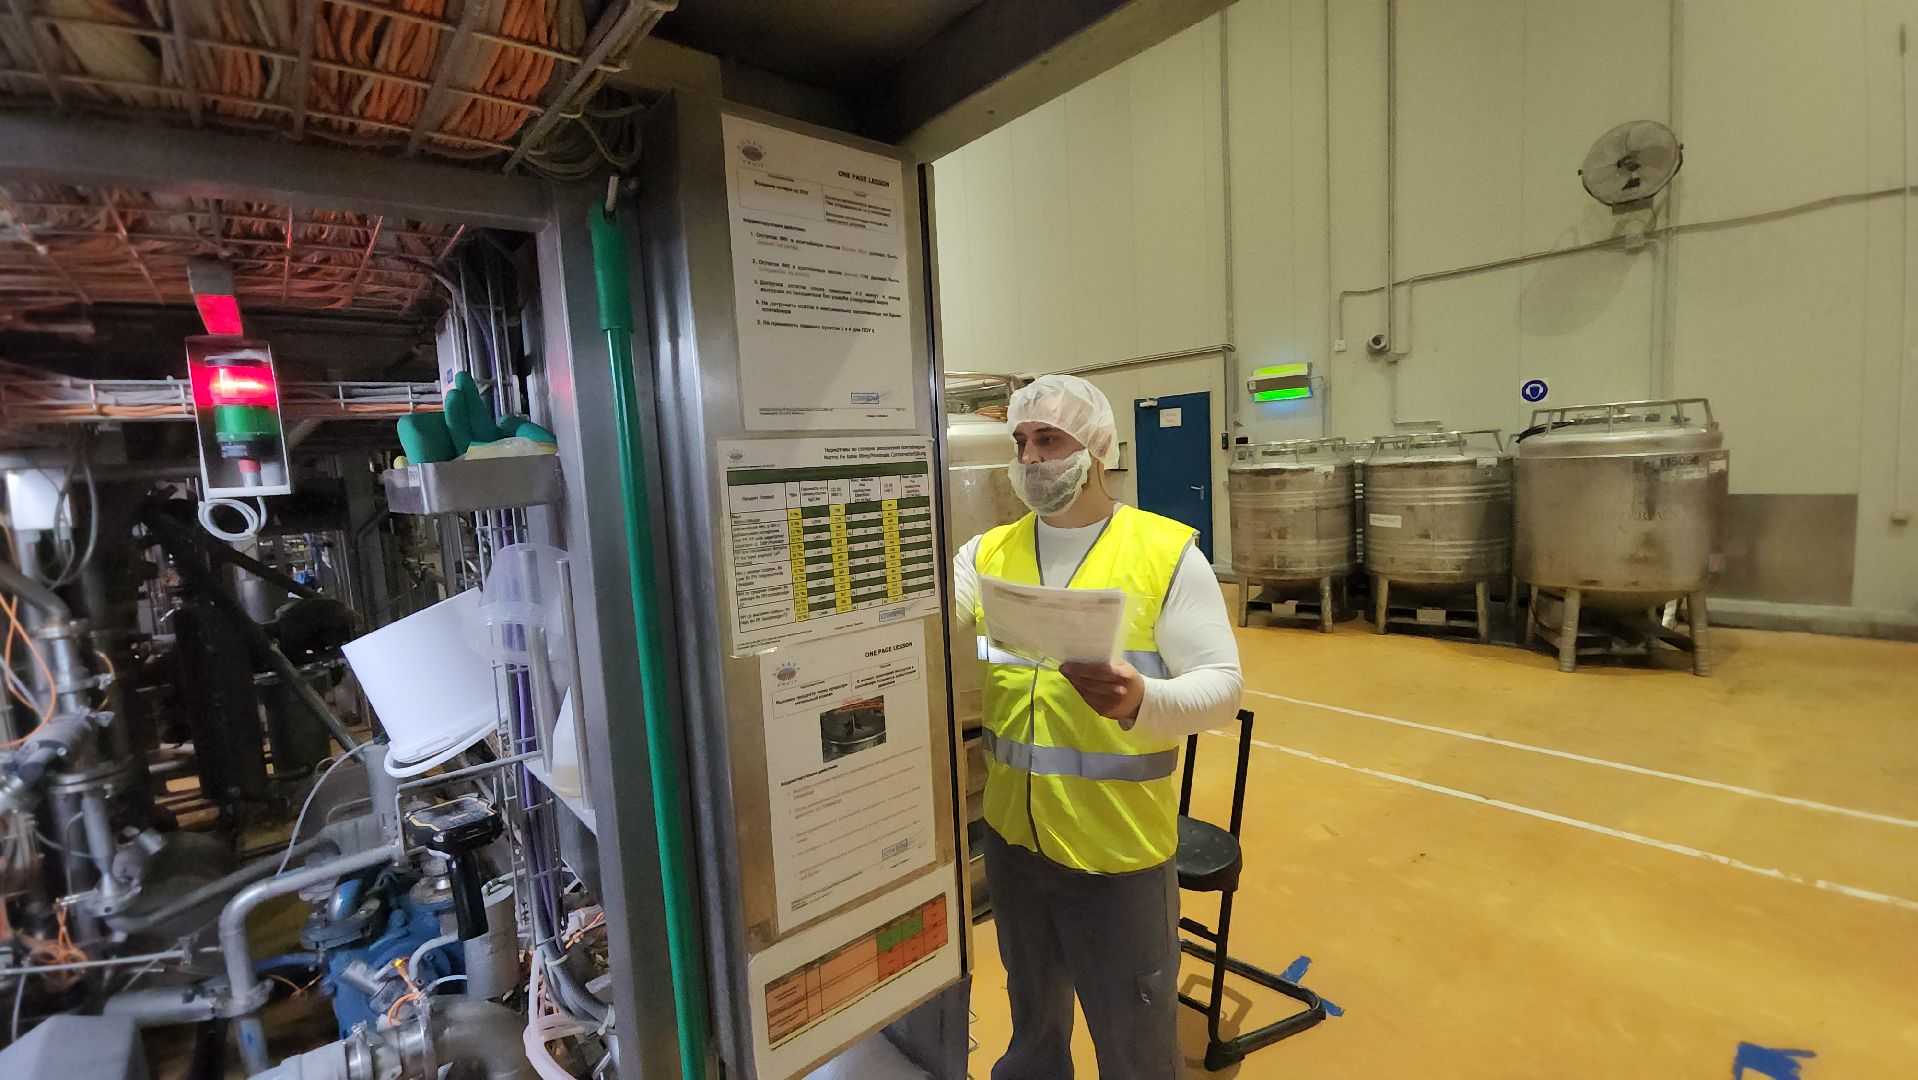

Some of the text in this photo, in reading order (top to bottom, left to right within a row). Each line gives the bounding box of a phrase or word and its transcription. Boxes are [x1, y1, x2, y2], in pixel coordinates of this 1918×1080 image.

[838, 170, 890, 188] ONE PAGE LESSON
[865, 641, 913, 658] ONE PAGE LESSON
